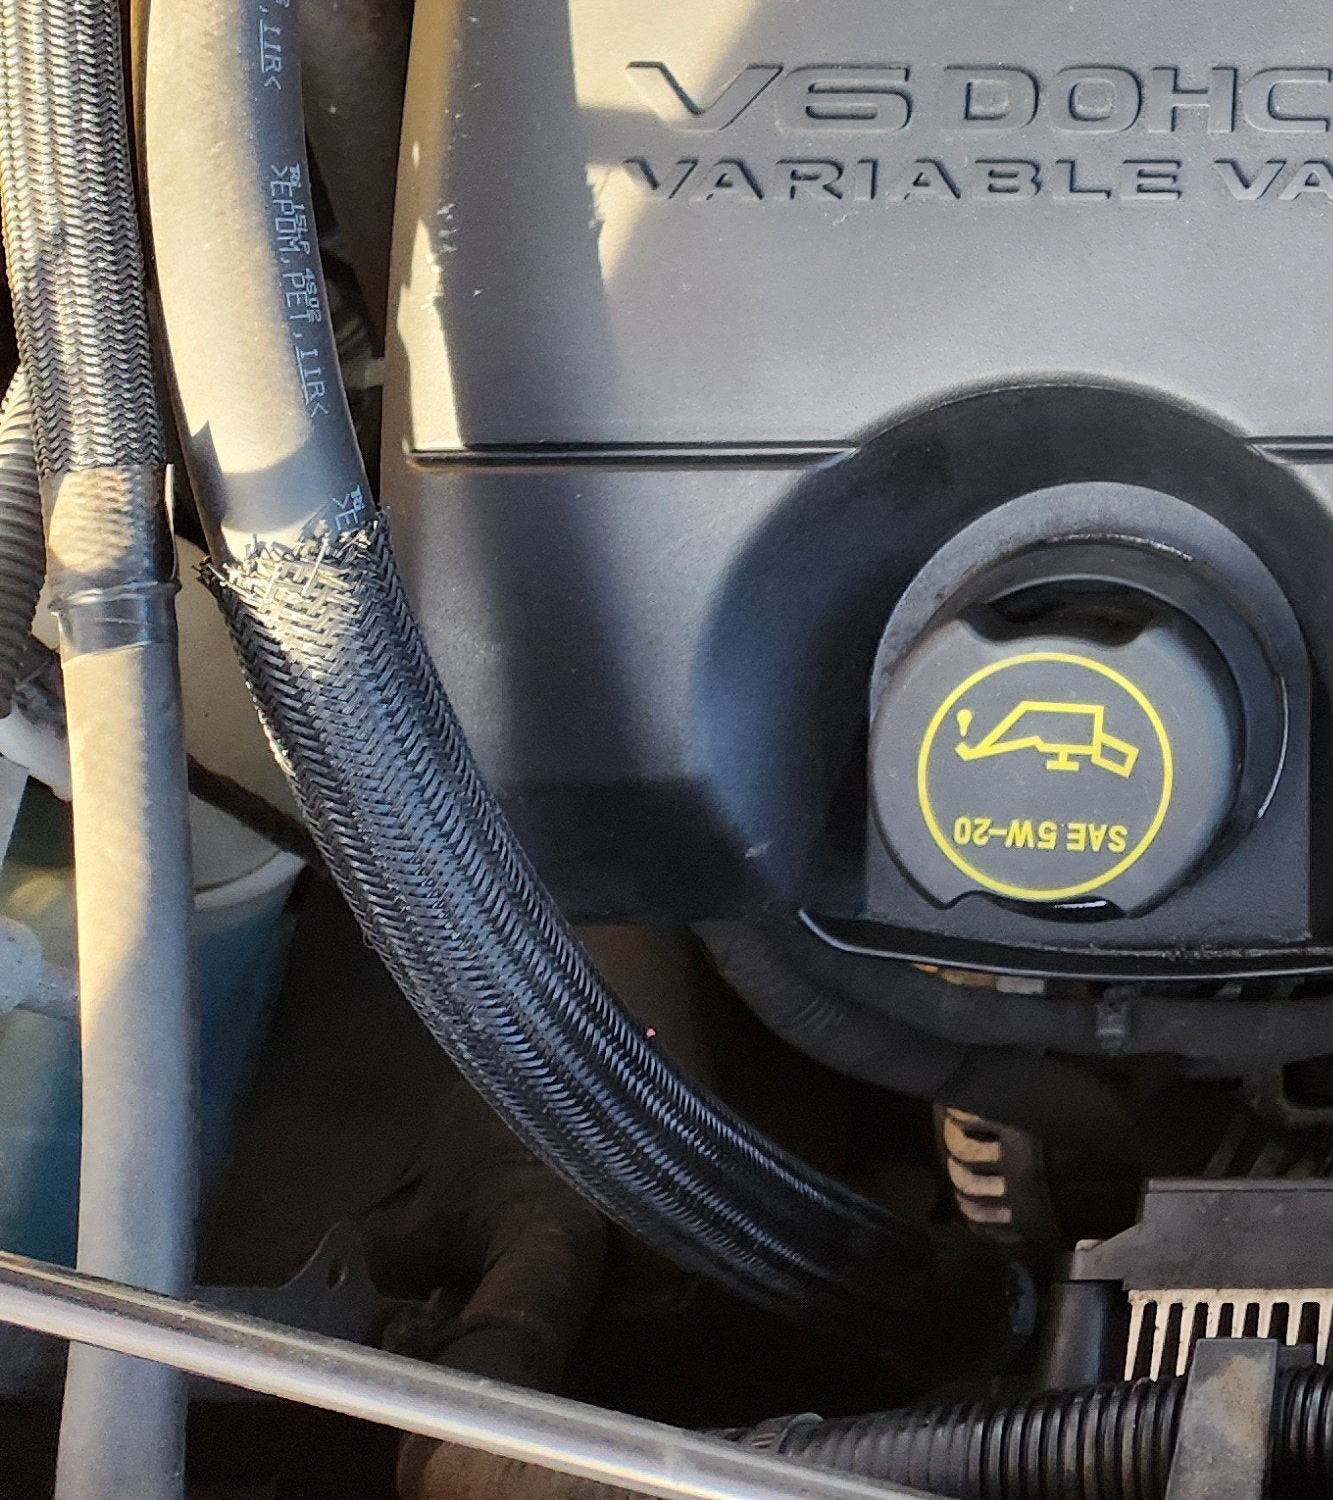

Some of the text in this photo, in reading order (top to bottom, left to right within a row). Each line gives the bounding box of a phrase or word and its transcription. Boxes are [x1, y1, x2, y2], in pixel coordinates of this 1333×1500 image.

[625, 60, 913, 133] V6
[942, 63, 1333, 134] DOHC
[620, 157, 1184, 201] VARIABLE
[952, 814, 1129, 854] SAE 5W-20
